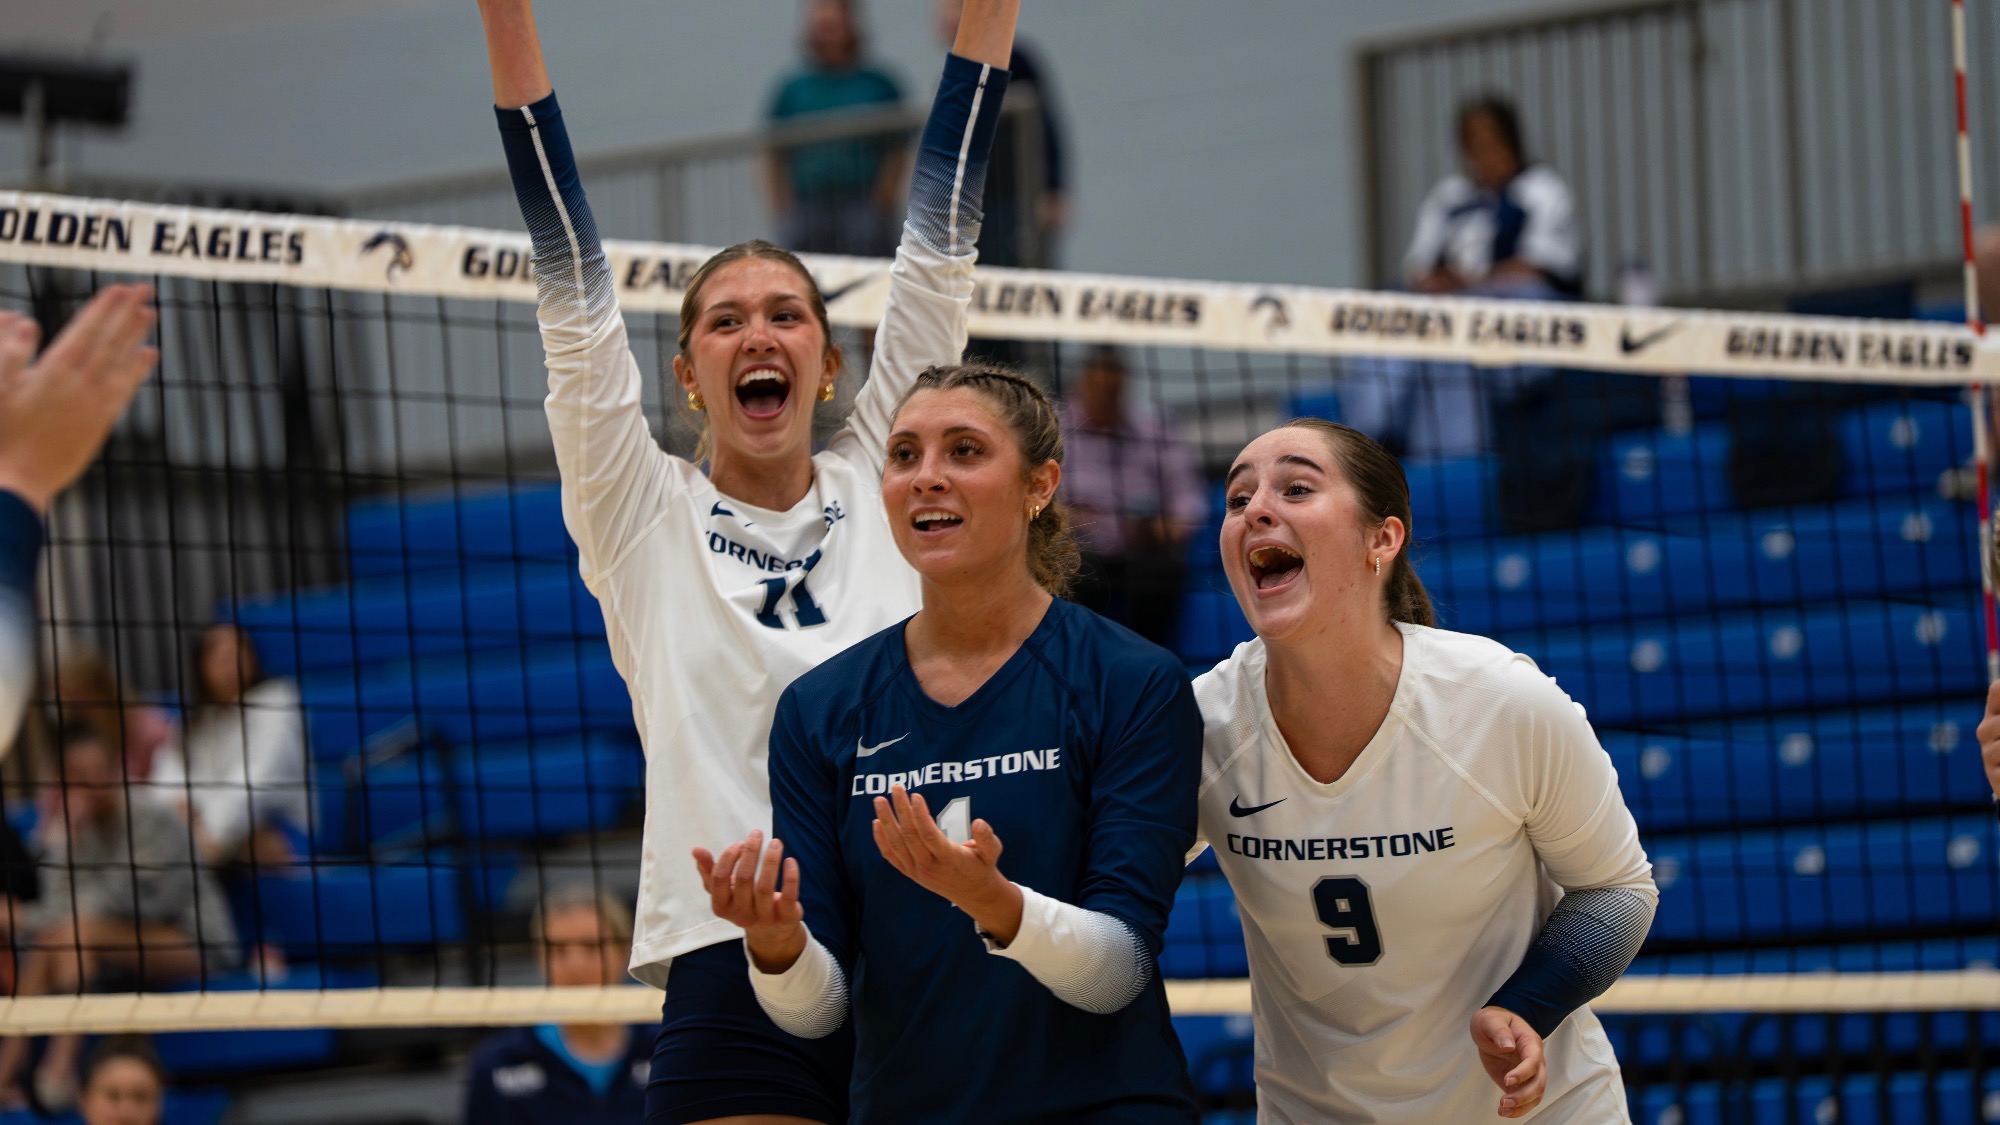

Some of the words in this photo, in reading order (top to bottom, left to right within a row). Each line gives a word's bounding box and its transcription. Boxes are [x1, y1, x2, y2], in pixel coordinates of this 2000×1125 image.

[0, 207, 132, 251] OLDEN
[151, 221, 305, 265] EAGLES
[462, 247, 536, 282] GOL
[625, 257, 698, 291] EAG
[974, 281, 1061, 317] LDEN
[1076, 286, 1201, 324] EAGLES
[1331, 303, 1453, 338] GOLDEN
[1468, 309, 1587, 345] EAGLES
[1726, 327, 1845, 363] GOLDEN
[1858, 333, 1973, 369] EAGLES
[754, 548, 830, 631] 11
[852, 748, 1060, 796] CORNERSTONE
[1227, 827, 1455, 861] CORNERSTONE
[1309, 874, 1385, 968] 9
